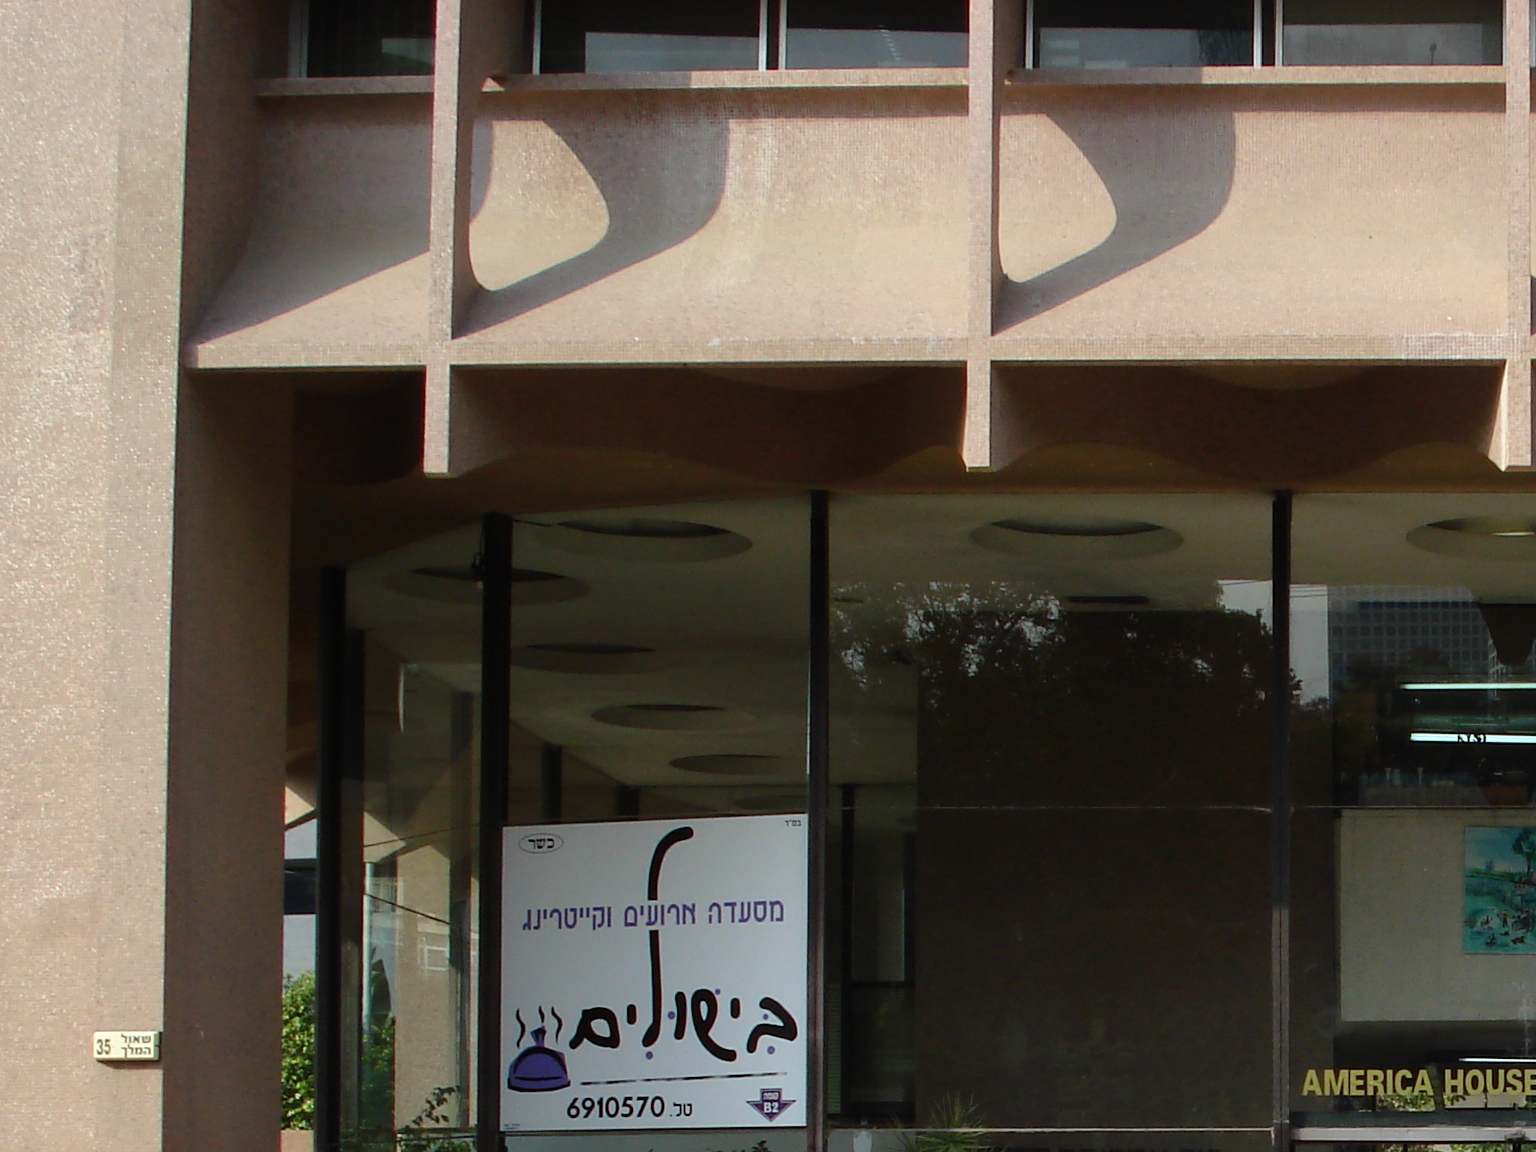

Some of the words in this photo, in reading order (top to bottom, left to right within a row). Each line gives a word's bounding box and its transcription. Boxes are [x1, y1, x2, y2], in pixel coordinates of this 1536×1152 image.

[528, 838, 555, 850] כשר
[522, 906, 612, 931] וקייטרינג
[624, 903, 696, 927] ארועים
[708, 900, 784, 924] מסעדה
[96, 1039, 111, 1055] 35
[121, 1033, 151, 1043] שאול
[121, 1044, 151, 1058] המלך
[1302, 1068, 1434, 1097] AMERICA
[567, 1096, 665, 1119] 6910570
[763, 1102, 780, 1113] B2
